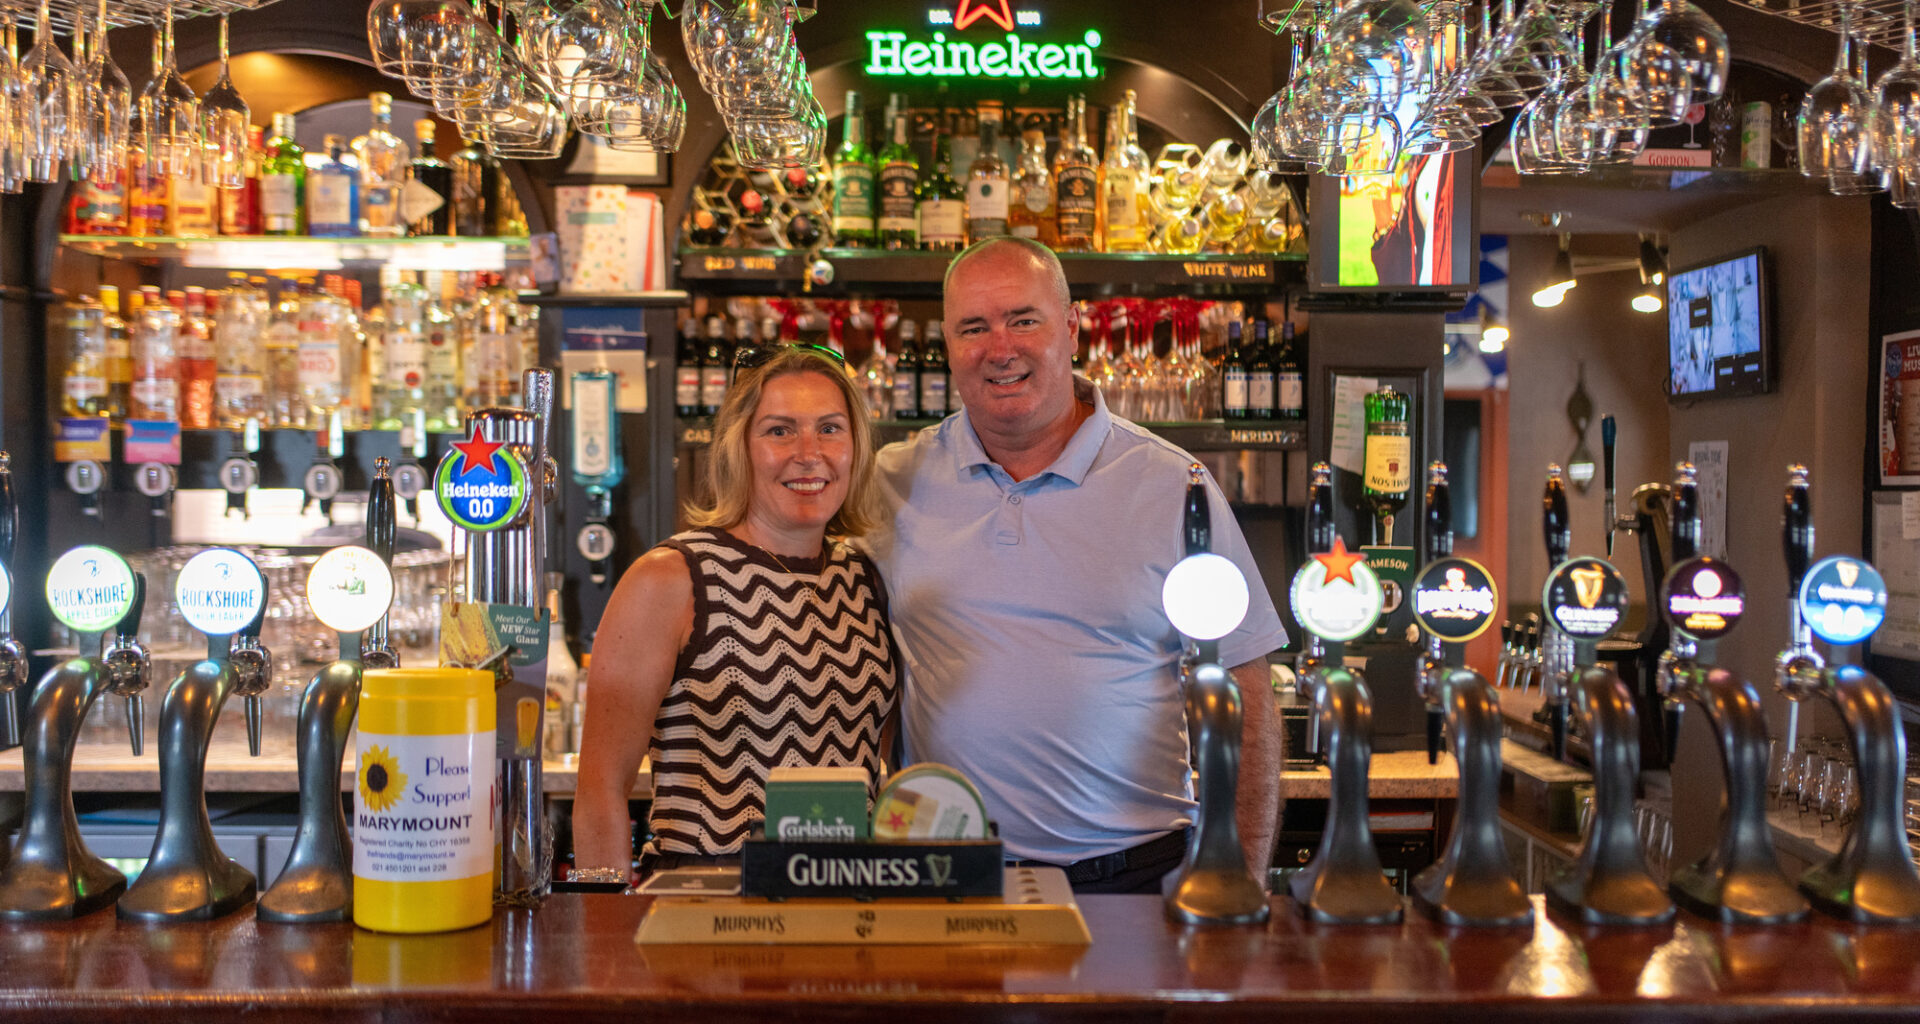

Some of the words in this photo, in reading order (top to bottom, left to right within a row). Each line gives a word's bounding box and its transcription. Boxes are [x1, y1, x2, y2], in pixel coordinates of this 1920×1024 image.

[866, 31, 1099, 77] Heineken
[1229, 263, 1267, 278] WINE
[1231, 429, 1282, 443] MERLOT
[443, 482, 519, 498] Heineken
[54, 582, 128, 608] ROCKSHORE
[182, 587, 256, 608] ROCKSHORE
[495, 614, 514, 623] Meet
[516, 616, 530, 625] Our
[500, 624, 524, 634] NEW
[525, 626, 540, 635] Star
[516, 634, 539, 645] Glass
[359, 814, 472, 831] MARYMOUNT
[778, 816, 855, 840] Carlsberg
[388, 838, 413, 849] Charity
[416, 840, 428, 848] No
[430, 839, 448, 848] CHY
[372, 863, 383, 872] 021
[419, 864, 431, 872] ext
[787, 853, 920, 886] GUINNESS
[713, 914, 786, 934] MURPHY'S
[946, 915, 1018, 936] MURPHY'S
